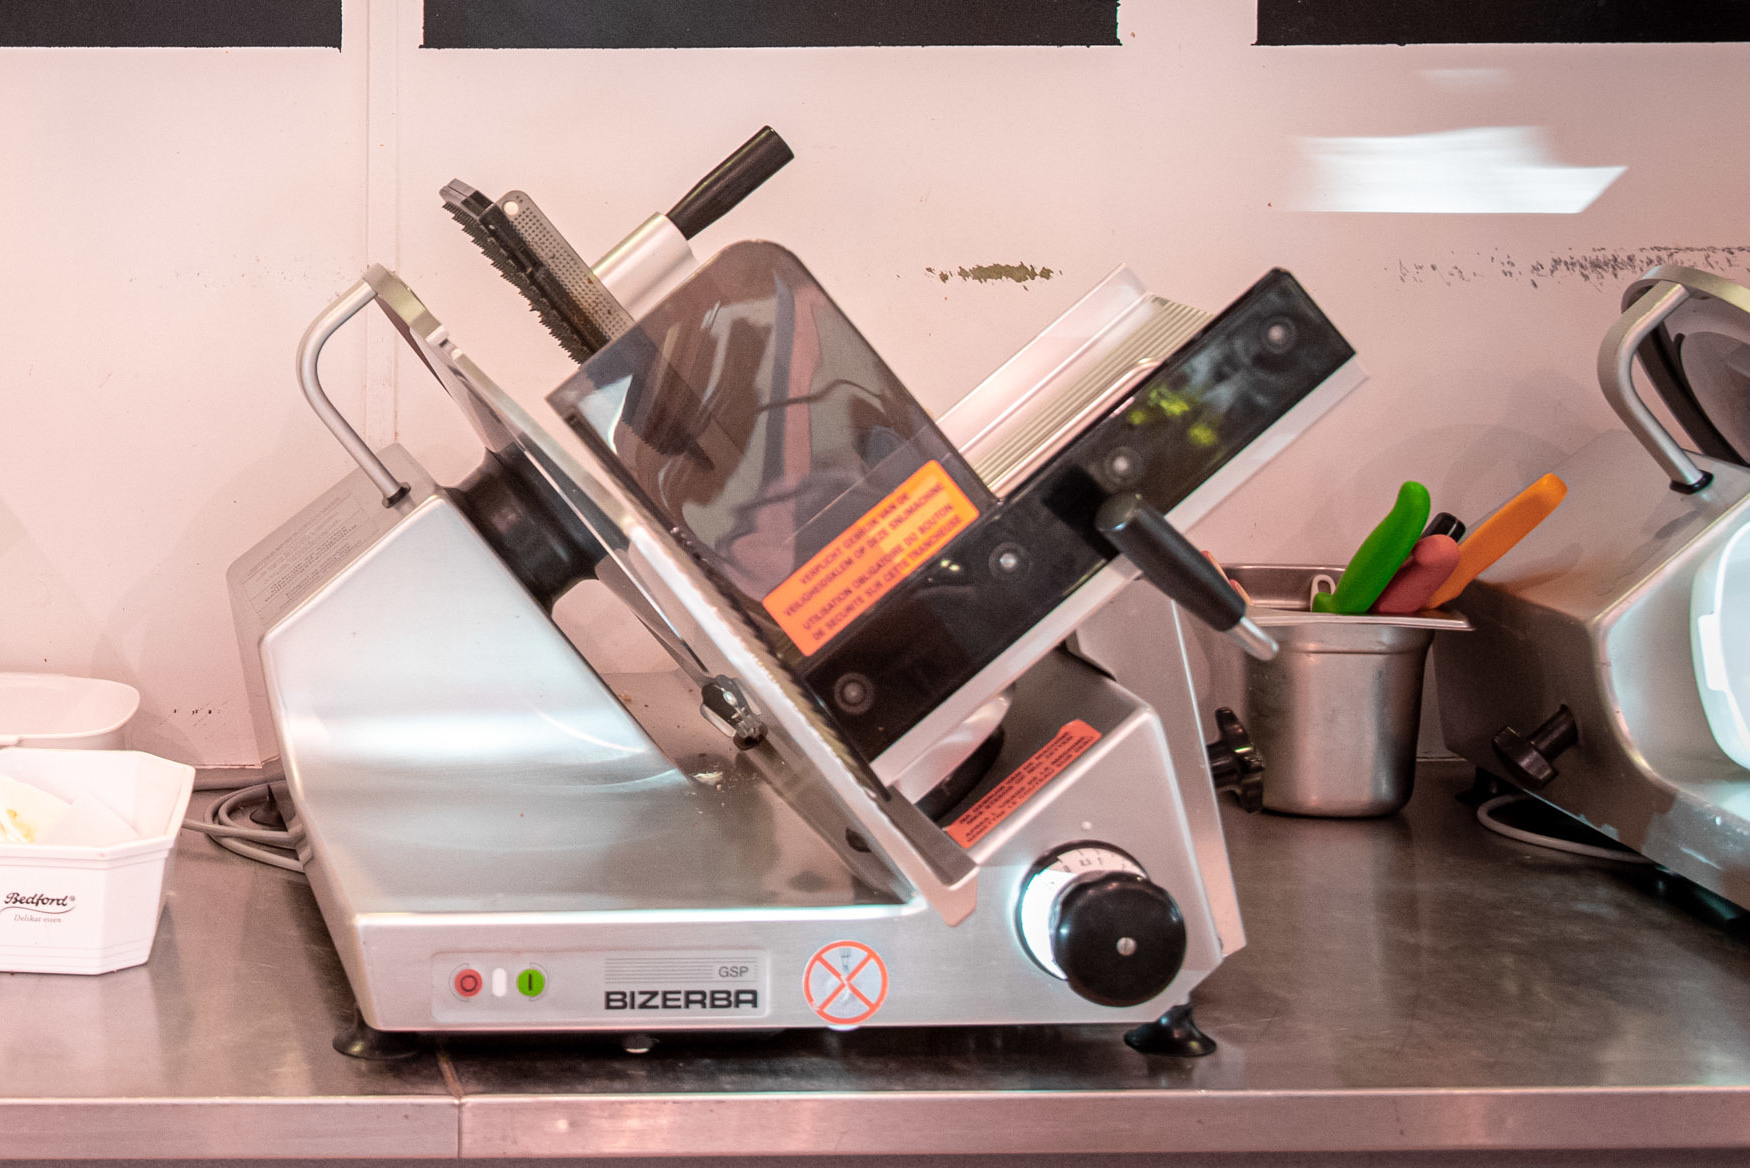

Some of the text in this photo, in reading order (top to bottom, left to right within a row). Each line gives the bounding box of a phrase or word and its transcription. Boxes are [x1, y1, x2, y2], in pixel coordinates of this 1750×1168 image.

[853, 545, 866, 558] OP
[802, 587, 851, 630] UTILISATION
[3, 892, 69, 907] Bedford
[718, 965, 749, 978] GSP
[604, 989, 758, 1010] BIZERBA
